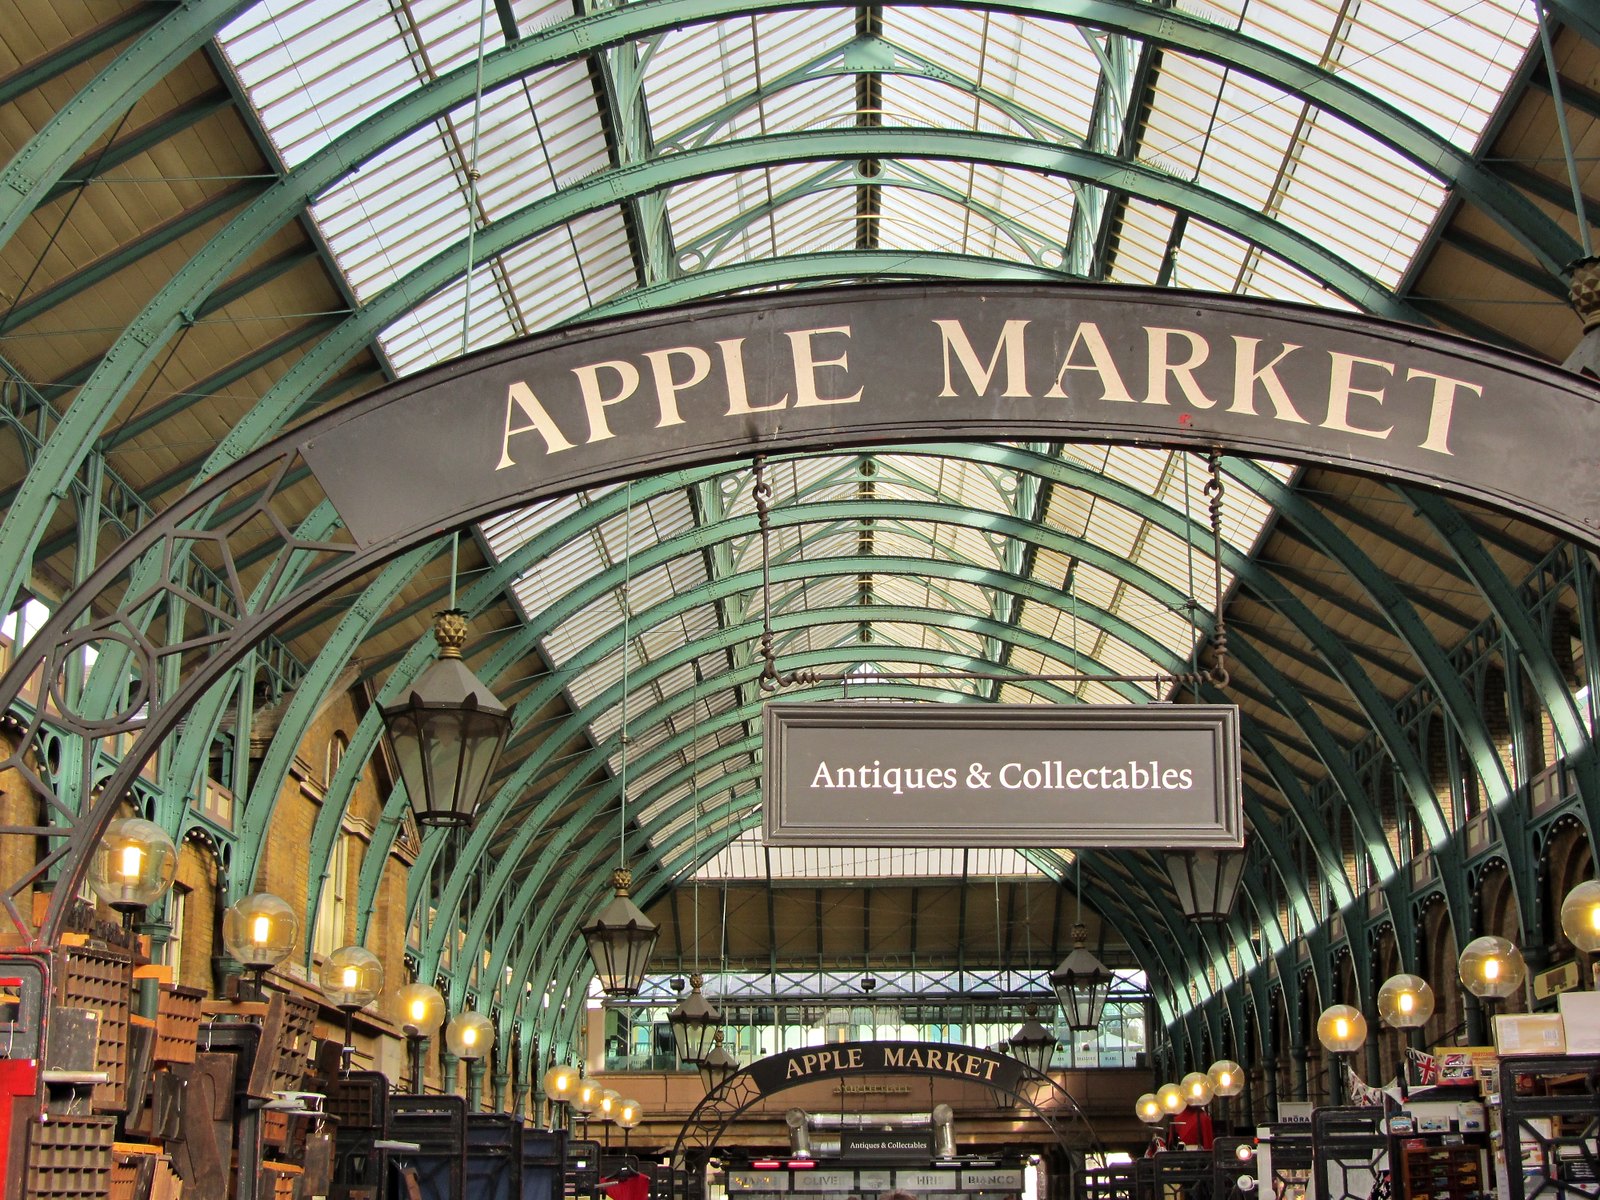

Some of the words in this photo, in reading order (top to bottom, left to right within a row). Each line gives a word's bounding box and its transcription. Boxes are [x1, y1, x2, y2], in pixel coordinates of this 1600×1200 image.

[494, 325, 865, 471] APPLE
[931, 319, 1484, 456] MARKET
[810, 760, 957, 794] Antiques
[965, 762, 992, 789] &
[999, 760, 1193, 790] Collectables
[786, 1048, 864, 1080] APPLE
[883, 1047, 1000, 1081] MARKET
[849, 1141, 880, 1150] Antiques
[881, 1141, 886, 1149] &
[887, 1141, 927, 1150] Collectables
[968, 1175, 1015, 1185] BIANCO
